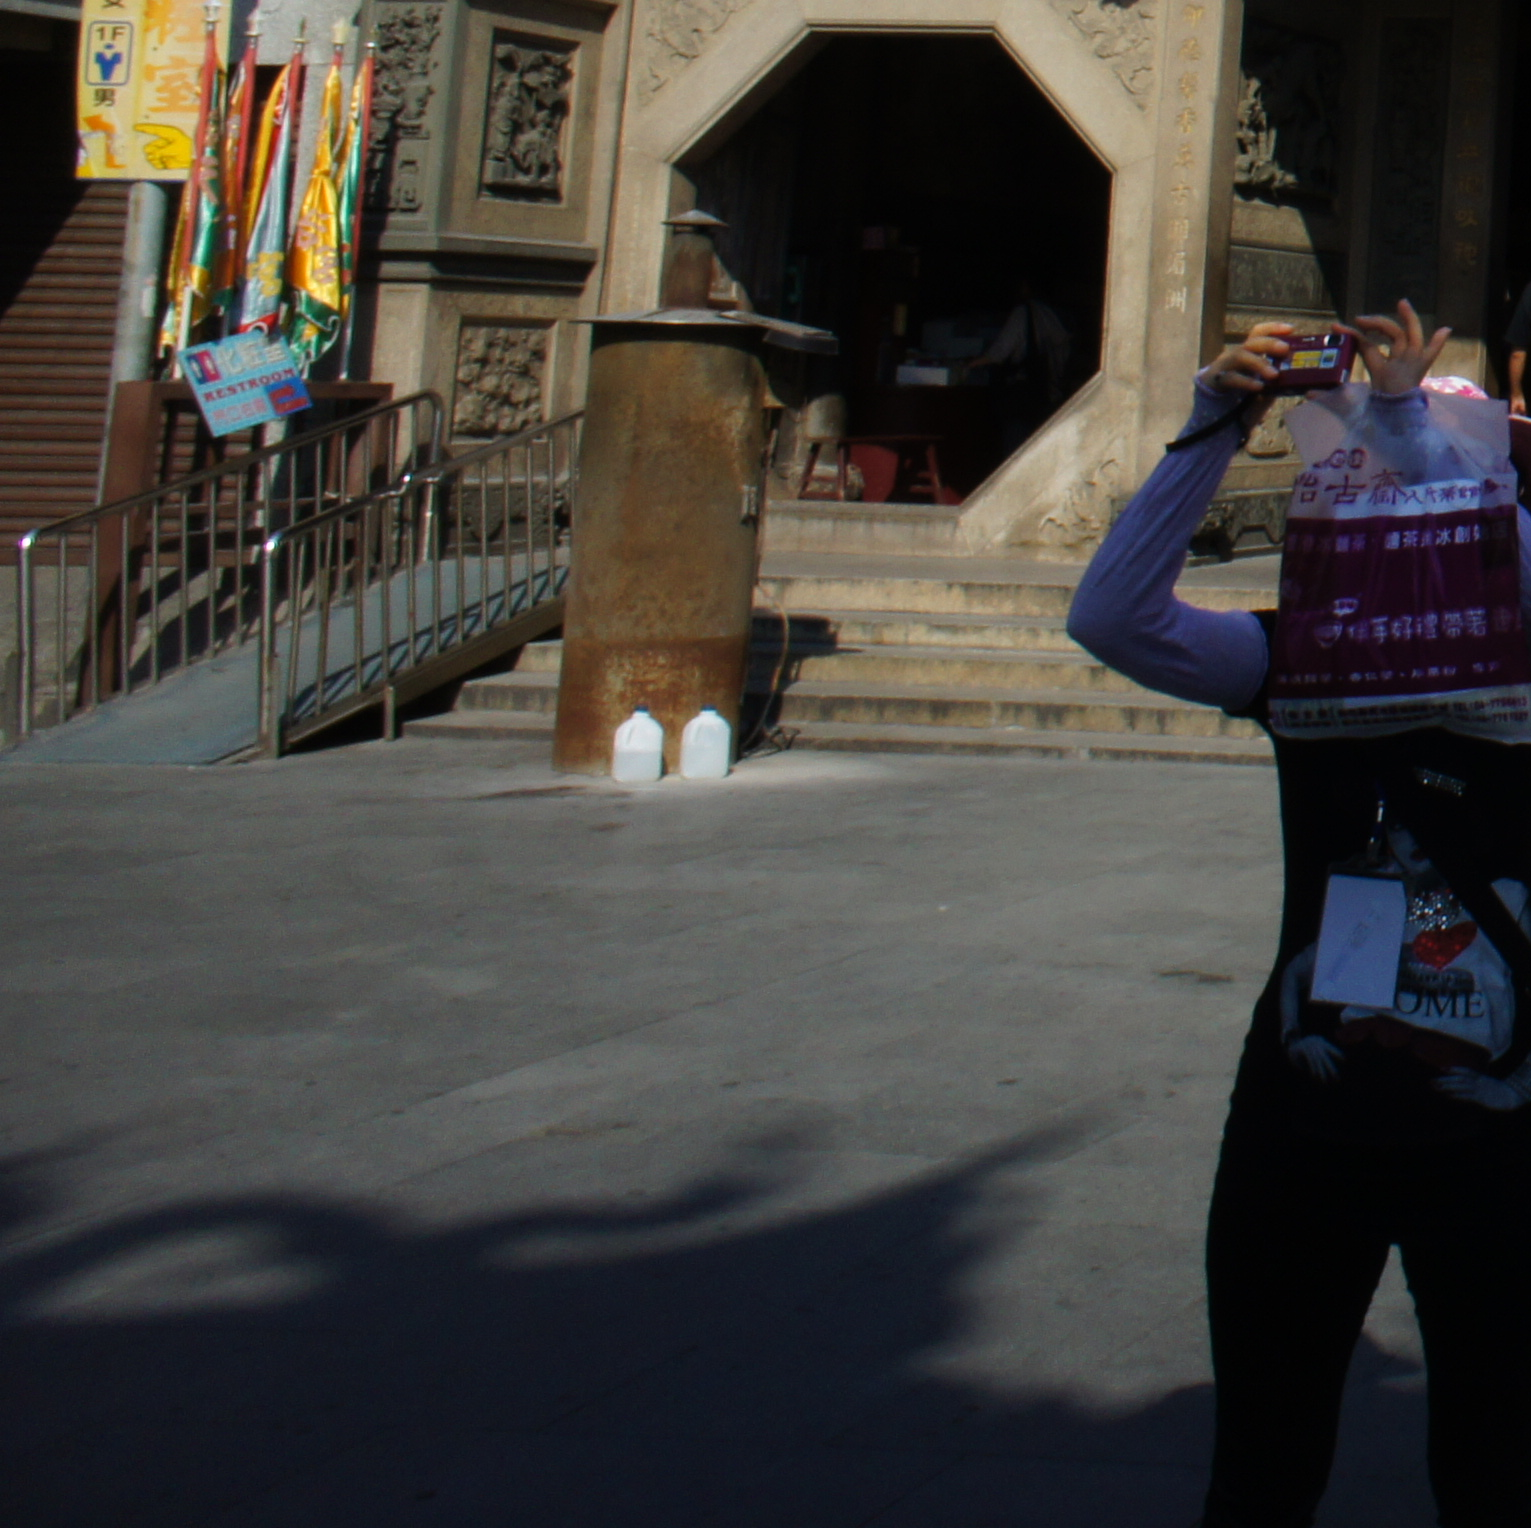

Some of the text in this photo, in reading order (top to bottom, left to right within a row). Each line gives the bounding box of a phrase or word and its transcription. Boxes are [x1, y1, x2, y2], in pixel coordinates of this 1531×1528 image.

[96, 25, 127, 42] 1F
[93, 88, 117, 108] 男
[203, 368, 296, 402] RESTROOM
[1396, 990, 1486, 1019] OME
